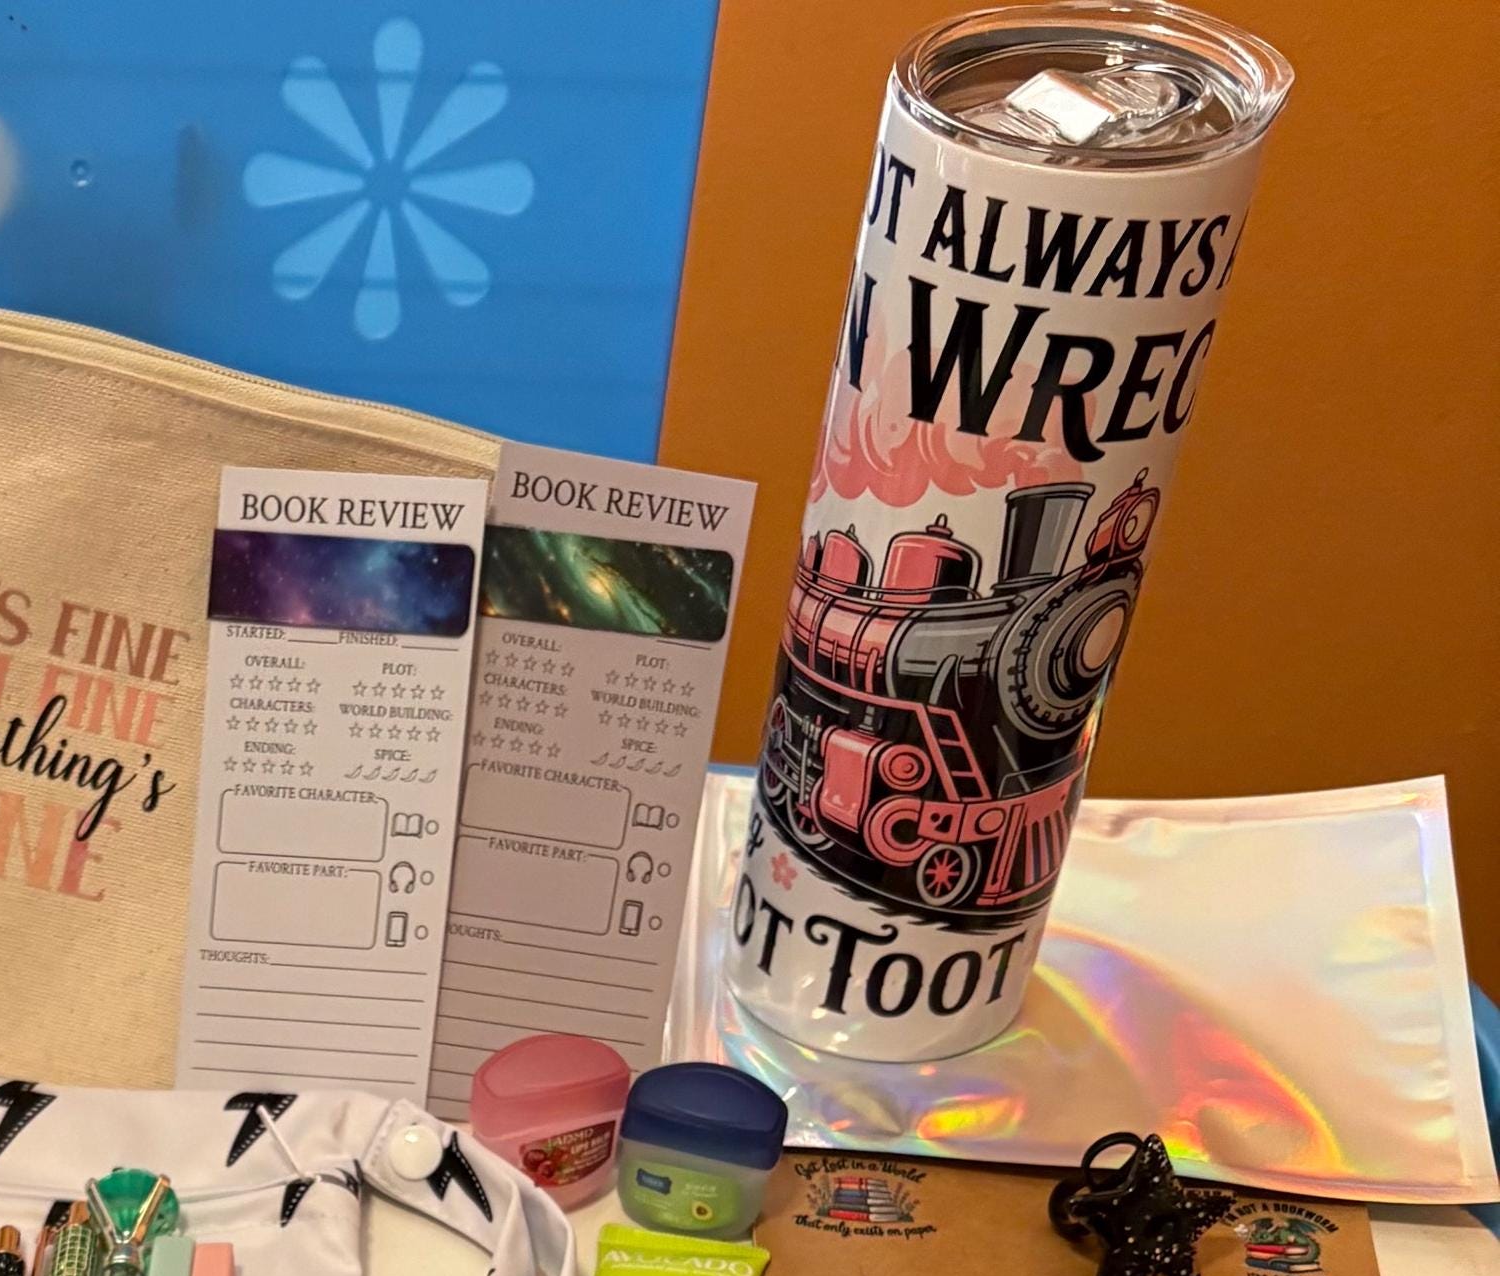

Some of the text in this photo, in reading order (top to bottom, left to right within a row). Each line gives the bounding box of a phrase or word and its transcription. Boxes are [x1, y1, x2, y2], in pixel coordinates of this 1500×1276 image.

[920, 184, 1231, 298] ALWAYS
[906, 275, 1217, 463] WREC
[240, 494, 465, 532] BOOK REVIEW
[511, 471, 730, 532] BOOK REVIEW
[49, 600, 191, 686] FINE
[226, 625, 286, 640] STARTED:
[501, 632, 670, 670] OVERALL: PLOT:
[245, 655, 417, 677] OVERALL: PLOT:
[38, 663, 182, 749] FINE
[229, 697, 453, 721] CHARACTERS: WORLD BUILDING:
[591, 689, 636, 708] WORLD
[244, 741, 412, 763] ENDING: SPICE:
[480, 759, 542, 780] FAVORITE
[234, 784, 297, 800] FAVORITE
[488, 836, 587, 863] FAVORITE PART:
[249, 861, 348, 878] FAVORITE PART:
[851, 1159, 864, 1170] in
[880, 1161, 927, 1183] World
[823, 1221, 937, 1239] only exists on paper
[1262, 1203, 1269, 1211] A
[1273, 1203, 1339, 1234] BOOKWORM
